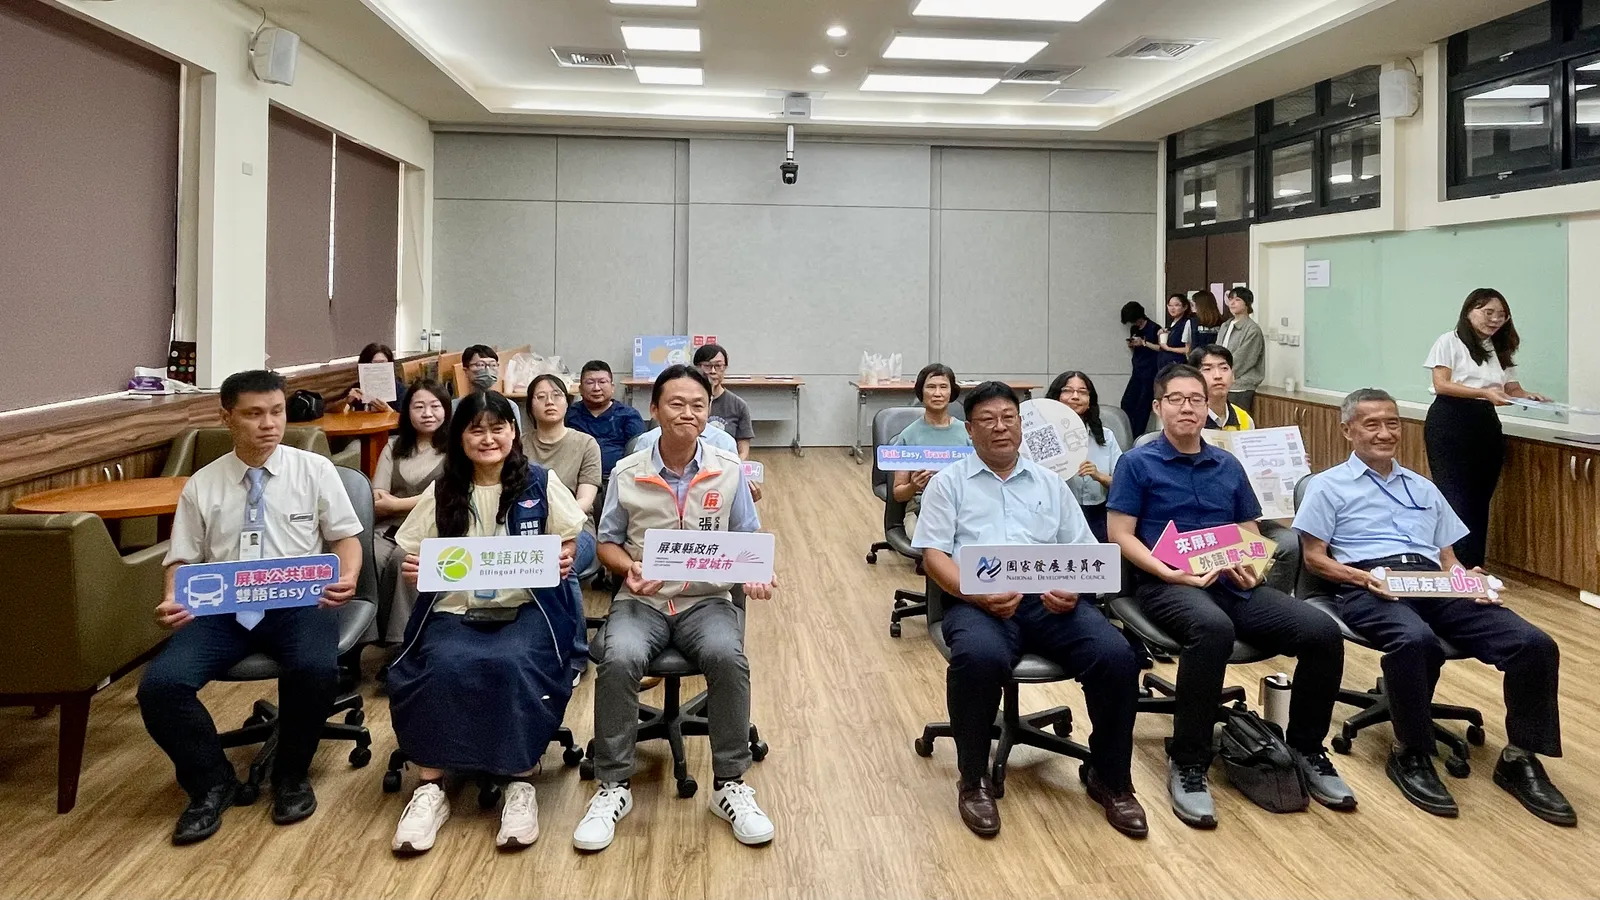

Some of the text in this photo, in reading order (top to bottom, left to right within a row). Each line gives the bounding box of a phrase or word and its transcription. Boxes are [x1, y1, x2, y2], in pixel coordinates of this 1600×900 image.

[881, 449, 900, 459] Talk
[902, 450, 922, 459] Easy,
[923, 449, 951, 459] Travel
[657, 542, 719, 555] 屏東縣政府
[1175, 532, 1218, 554] 來屏東
[480, 549, 544, 566] 雙語政策
[686, 557, 734, 570] 希望城市
[1006, 559, 1105, 573] 國家發展委員會
[235, 564, 332, 586] 屏東公共運輸
[310, 584, 324, 596] G
